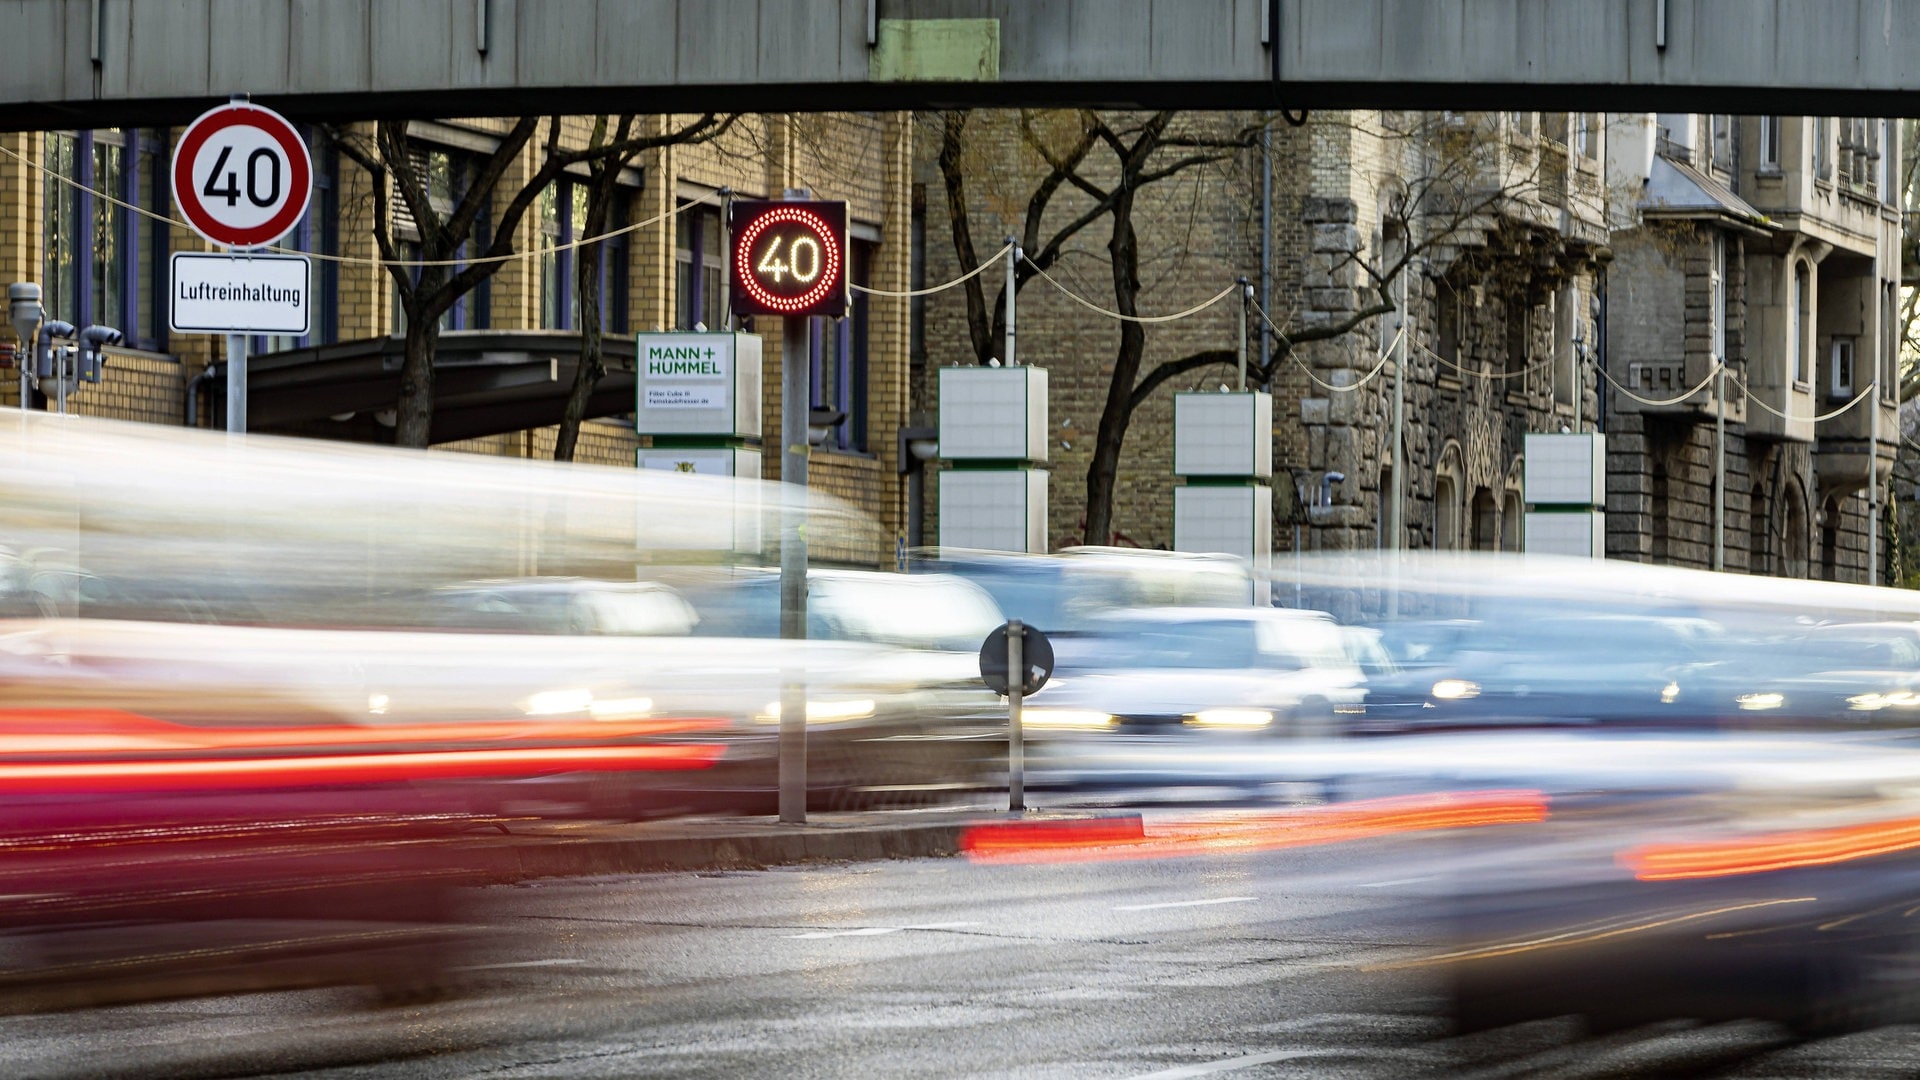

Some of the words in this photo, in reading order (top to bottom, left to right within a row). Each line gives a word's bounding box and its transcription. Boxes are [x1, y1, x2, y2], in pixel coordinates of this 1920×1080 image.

[204, 146, 281, 208] 40
[758, 236, 819, 283] 40
[180, 281, 301, 308] Luftreinhaltung
[649, 361, 722, 375] HUMMEL
